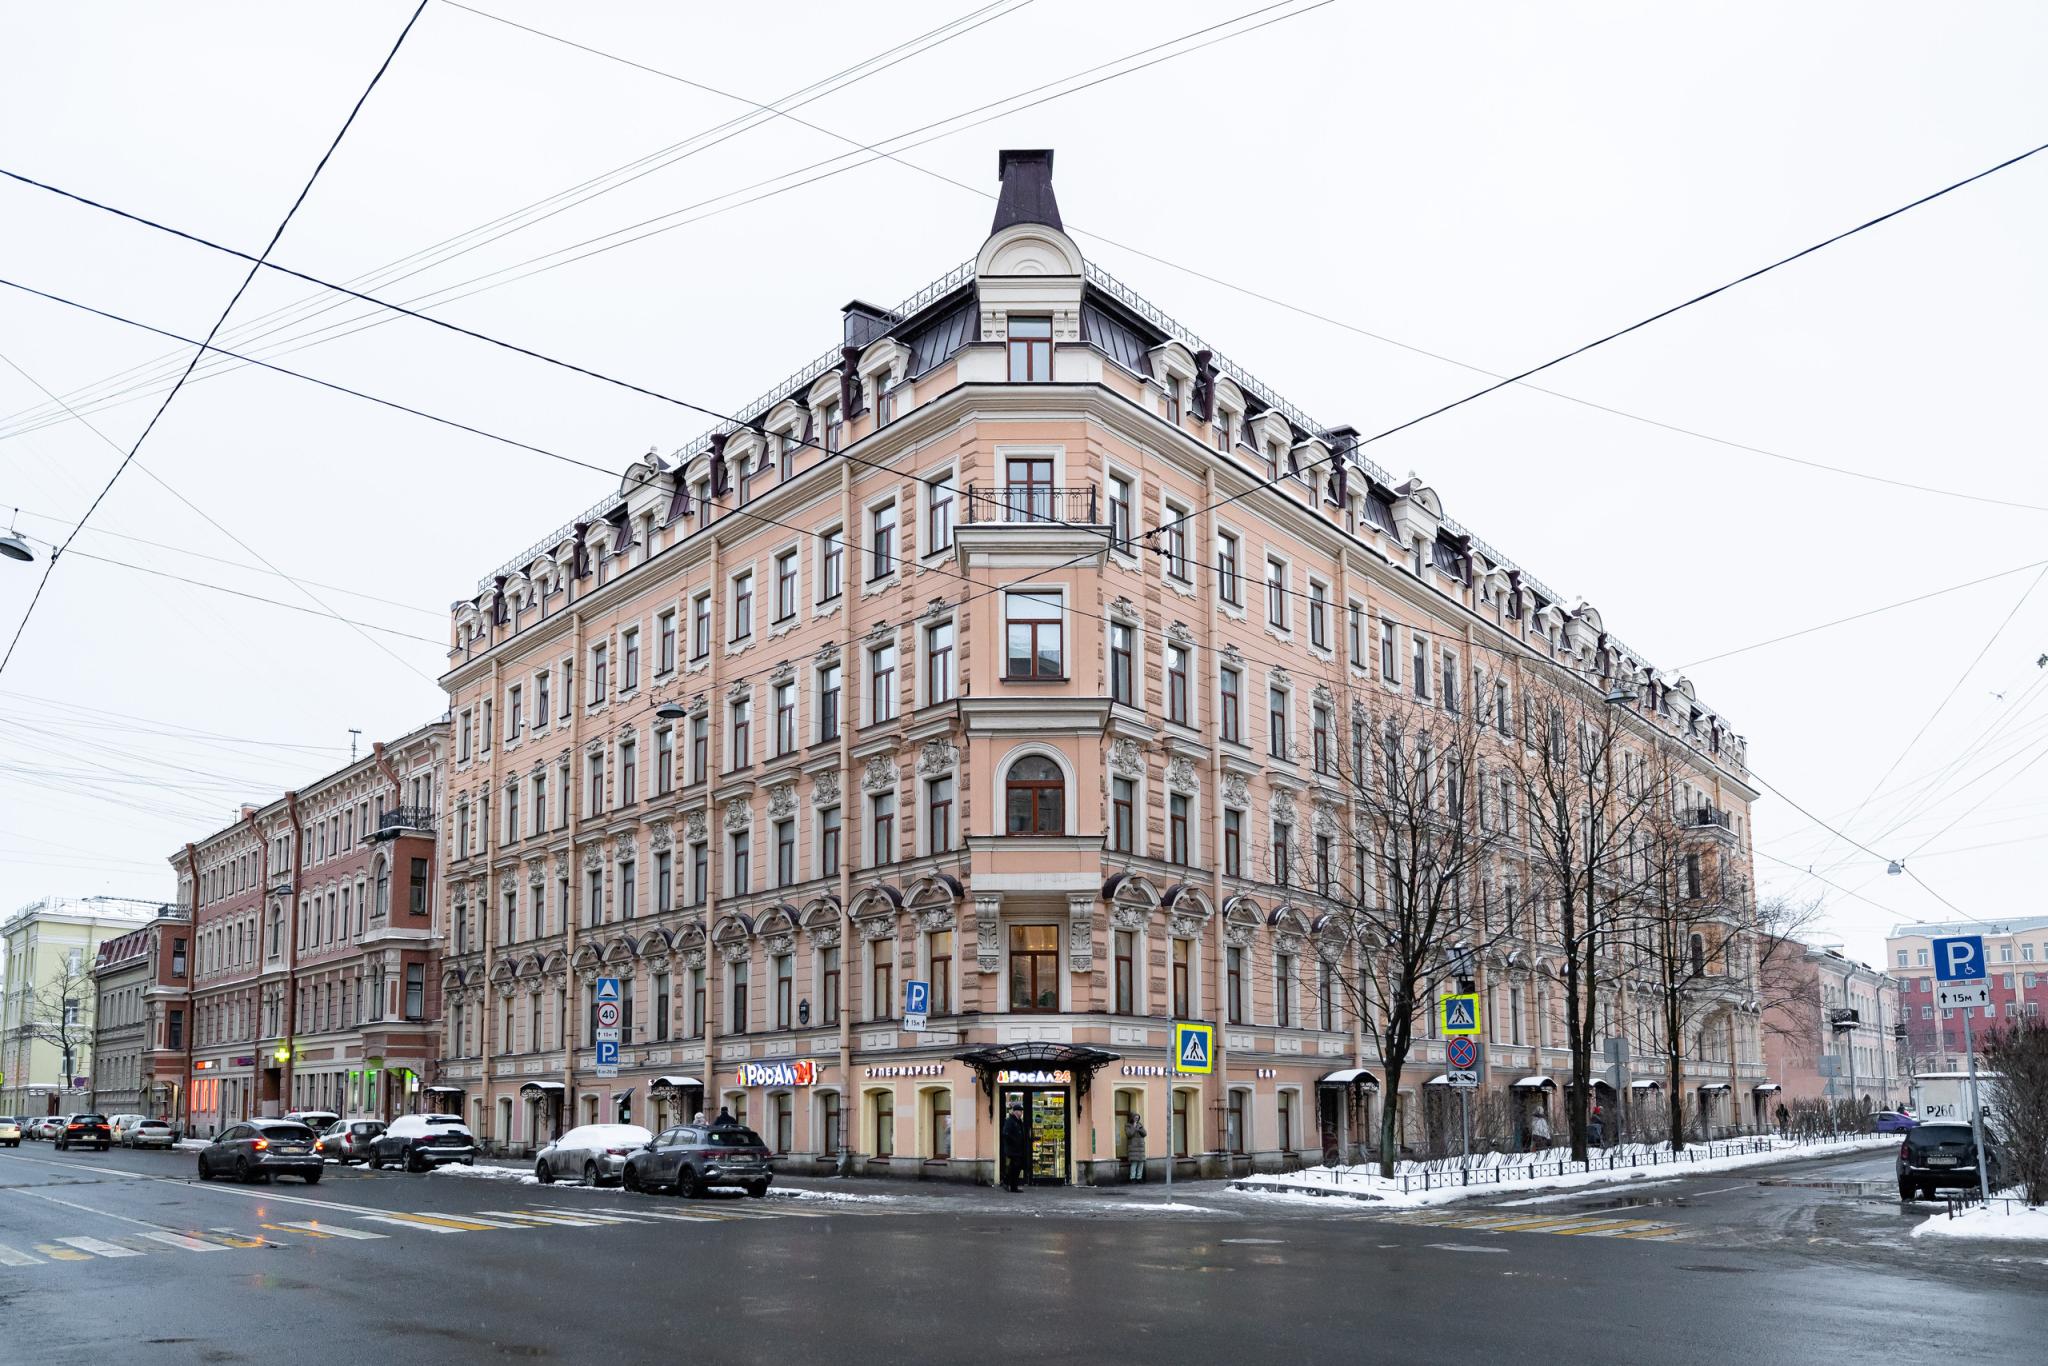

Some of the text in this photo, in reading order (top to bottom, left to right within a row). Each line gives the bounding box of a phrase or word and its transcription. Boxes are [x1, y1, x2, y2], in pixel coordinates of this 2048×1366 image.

[601, 1009, 615, 1020] 40
[864, 1064, 944, 1078] СУПЕРМАРКЕТ
[1258, 1068, 1277, 1078] БАР
